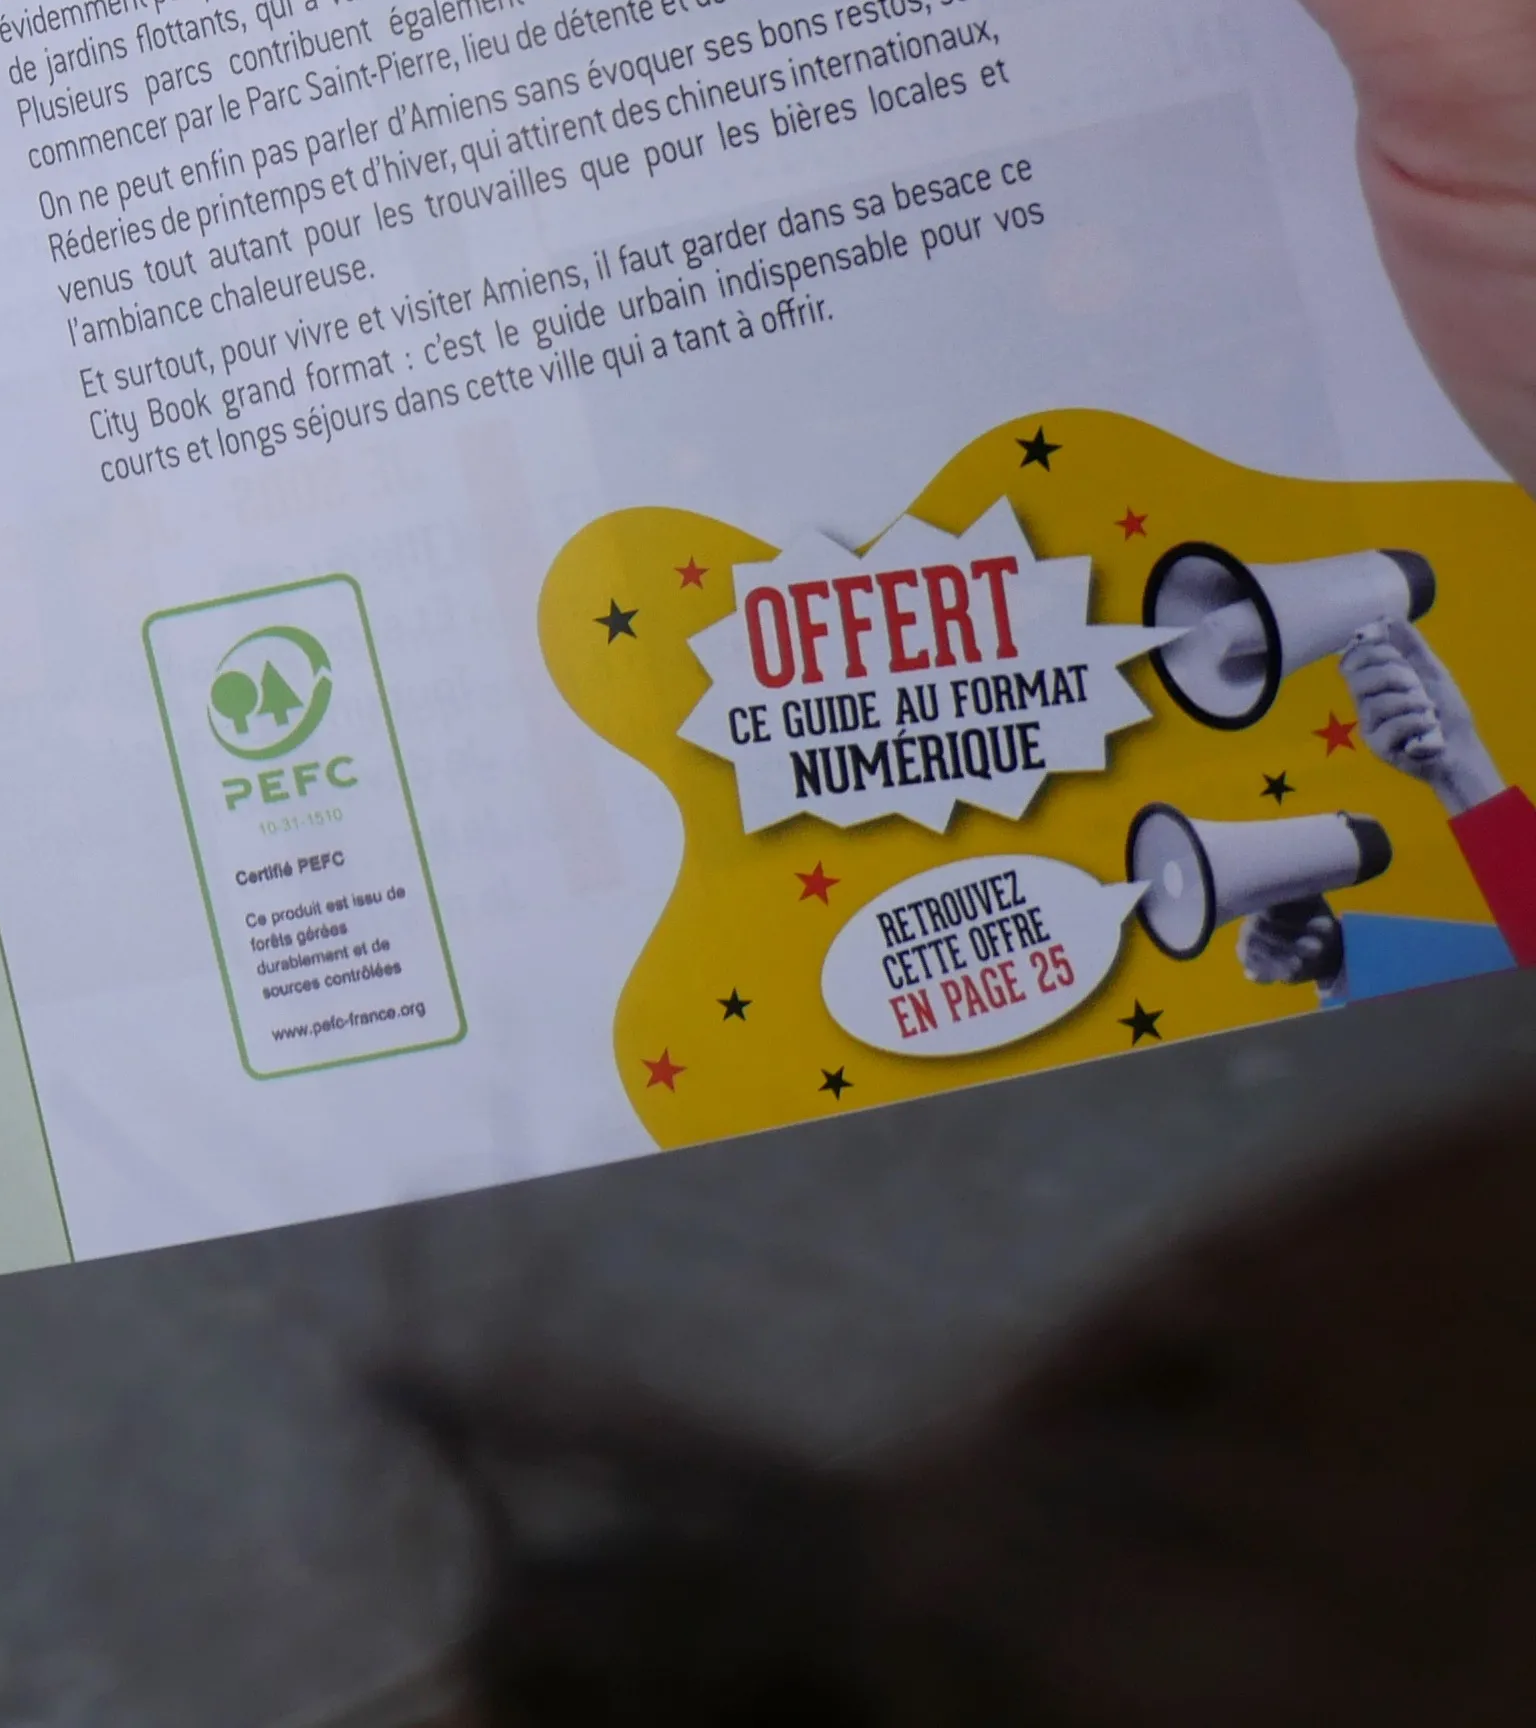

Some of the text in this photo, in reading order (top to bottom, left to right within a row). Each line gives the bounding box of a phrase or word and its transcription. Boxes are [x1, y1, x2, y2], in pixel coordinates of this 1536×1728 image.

[100, 293, 834, 483] courts et longs séjours dans cette ville qui a tant à offrir.
[744, 555, 1020, 690] OFFERT
[729, 663, 1091, 746] CE GUIDE AU FORMAT
[222, 756, 358, 810] PEFC
[789, 722, 1046, 799] NUMÉRIQUE
[234, 849, 346, 887] Certifié PEFC
[244, 885, 407, 929] Ce produit est issu de
[249, 922, 349, 953] forêts gérées
[876, 870, 1027, 949] RETROUVEZ
[256, 937, 391, 976] durablement et de
[261, 961, 403, 1001] sources contrôlées
[881, 906, 1051, 991] CETTE OFFRE
[270, 1001, 427, 1043] www.pefc-france.org
[887, 944, 1076, 1040] EN PAGE 25
